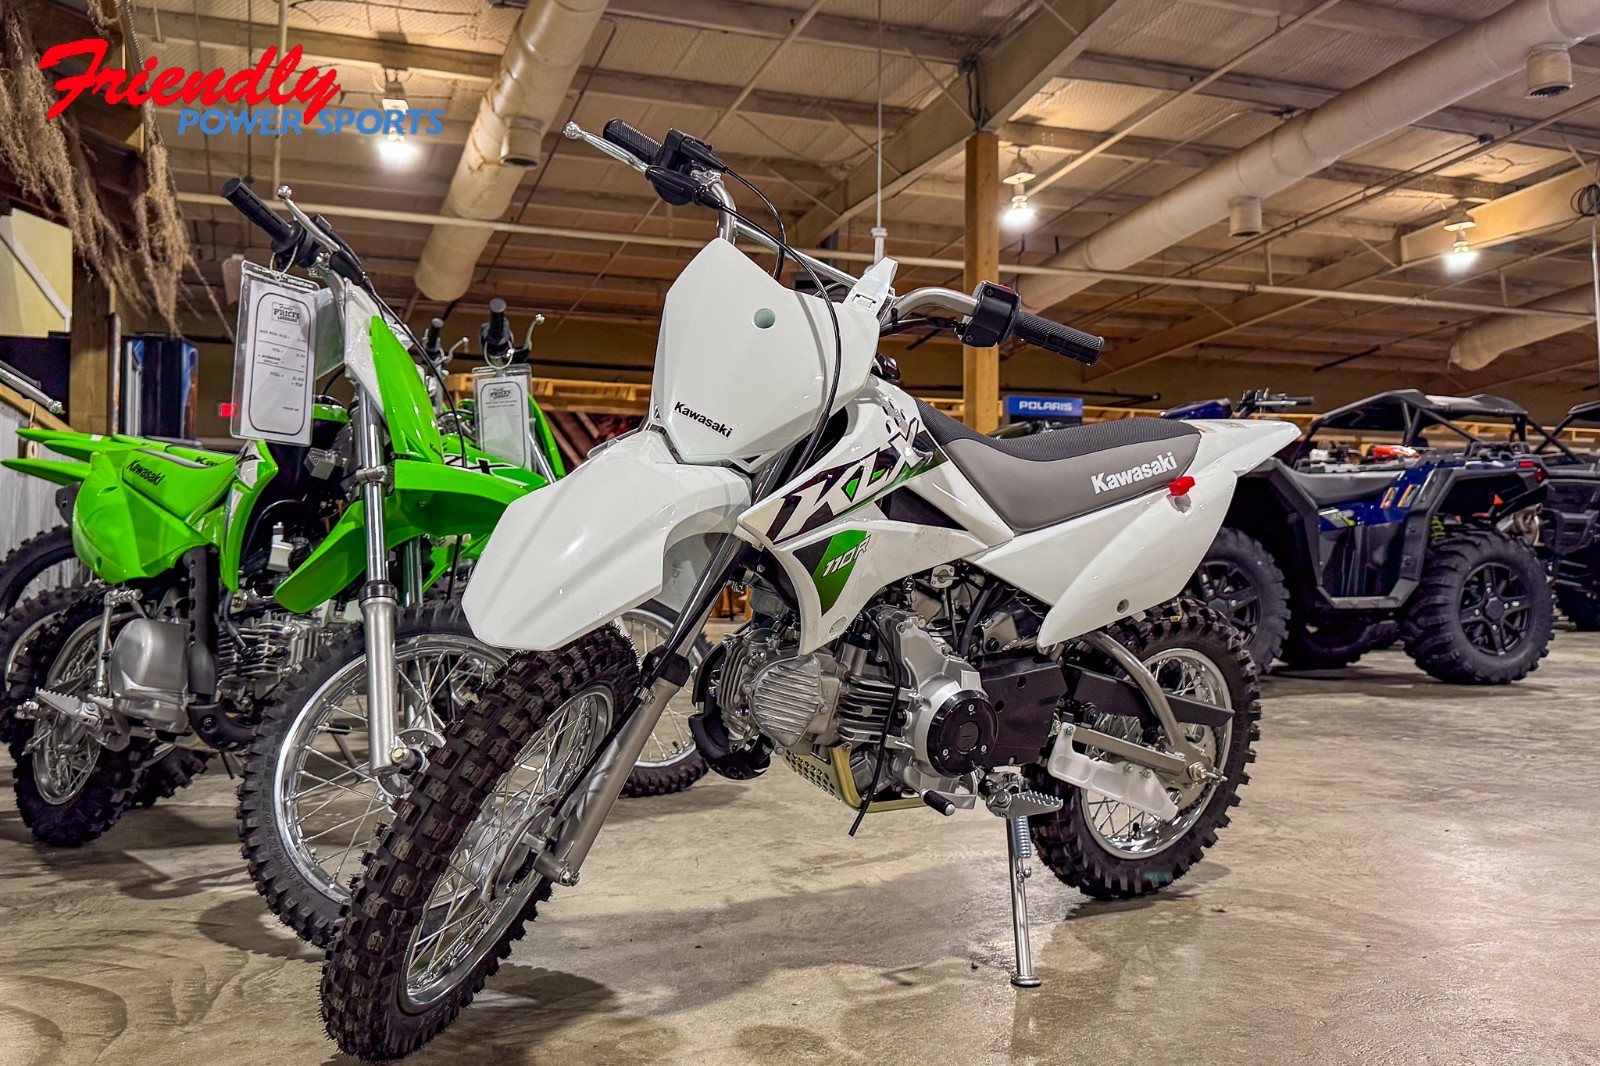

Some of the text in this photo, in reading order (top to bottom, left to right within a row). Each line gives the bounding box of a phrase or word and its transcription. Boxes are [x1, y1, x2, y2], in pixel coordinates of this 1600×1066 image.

[674, 401, 733, 438] Kawasaki
[1018, 400, 1074, 412] POLARIS
[126, 459, 166, 486] Kawasaki
[770, 416, 926, 545] KLX
[1090, 451, 1178, 495] Kawasaki
[821, 534, 872, 579] 110R
